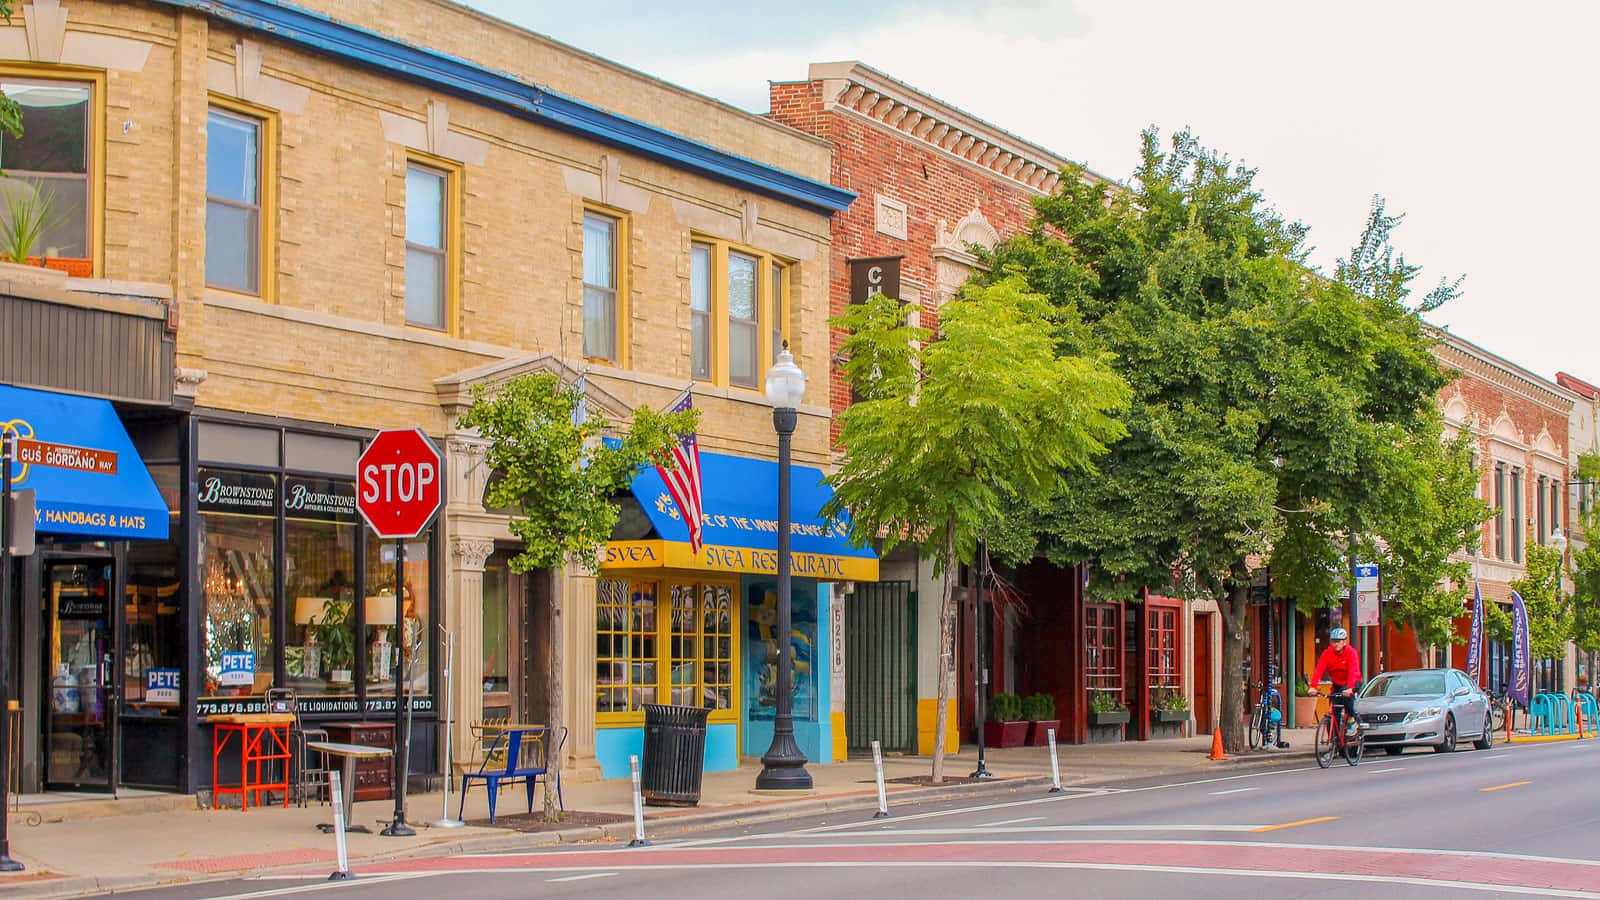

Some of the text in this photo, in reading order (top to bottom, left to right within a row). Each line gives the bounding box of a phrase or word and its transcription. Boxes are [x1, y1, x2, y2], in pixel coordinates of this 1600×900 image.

[21, 447, 113, 471] GUS GIORDANO WAY
[363, 462, 435, 504] STOP
[46, 509, 107, 527] HANDBAGS
[109, 514, 117, 527] &
[120, 515, 146, 529] HATS
[714, 515, 729, 528] OF
[729, 516, 753, 530] THE
[607, 546, 656, 562] SVEA
[706, 547, 845, 576] SVEA RESAURANT
[223, 654, 253, 670] PETE
[148, 671, 181, 688] PETE
[309, 701, 358, 712] LIQUIDATIONS
[365, 700, 432, 710] 773.87.800
